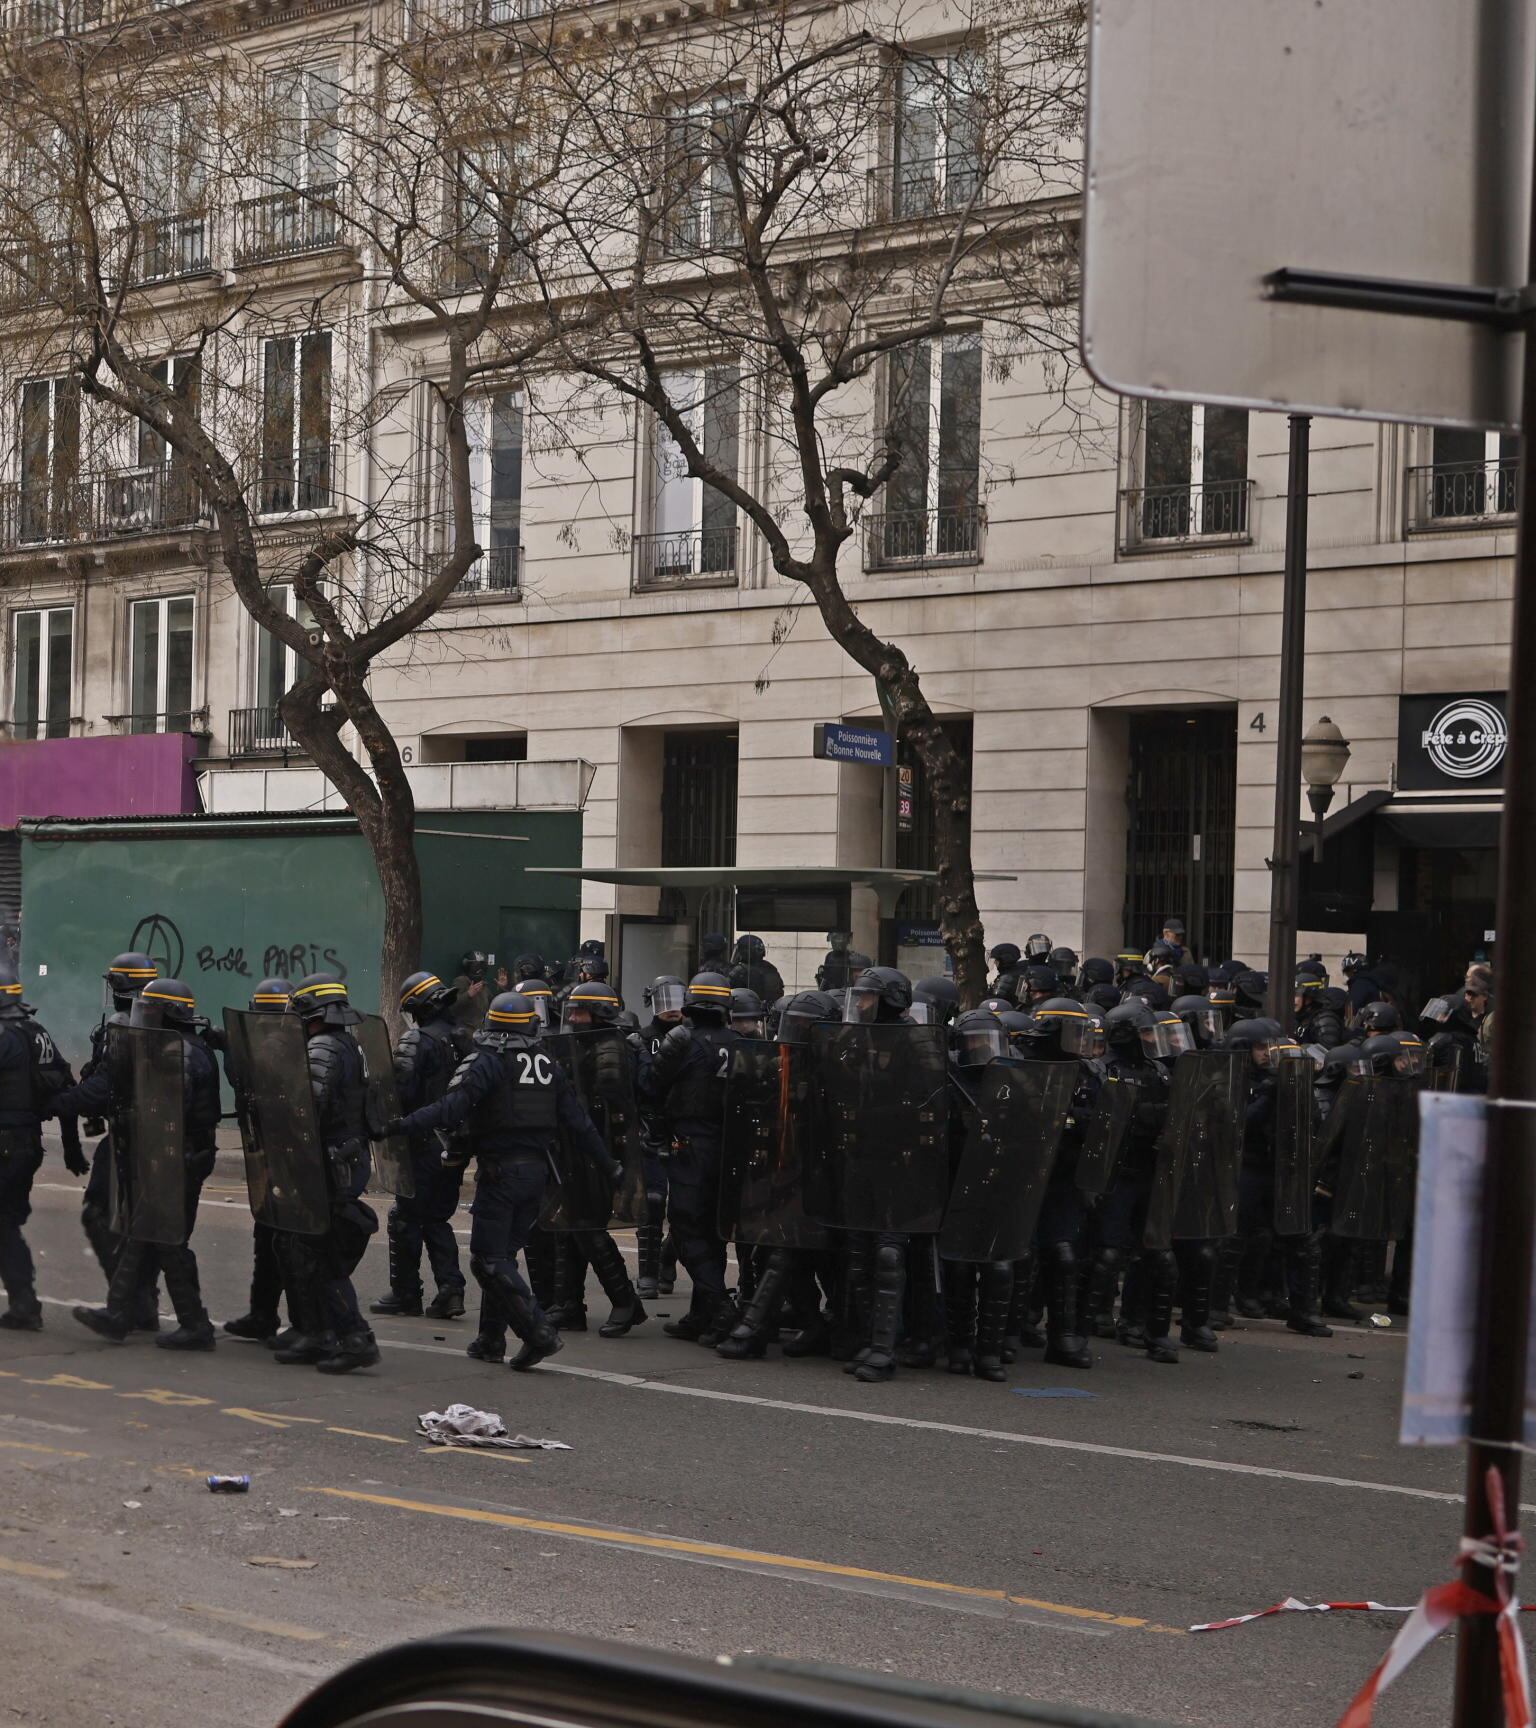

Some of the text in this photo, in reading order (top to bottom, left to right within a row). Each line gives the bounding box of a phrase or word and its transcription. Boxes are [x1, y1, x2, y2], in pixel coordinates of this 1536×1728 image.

[1250, 712, 1266, 733] 4
[838, 730, 878, 747] Poissonnière
[402, 746, 413, 763] 6
[833, 743, 882, 760] Bonne Nouvelle
[900, 770, 910, 783] 20
[899, 800, 910, 814] 39
[1345, 957, 1359, 966] TV
[516, 1052, 553, 1085] 2C
